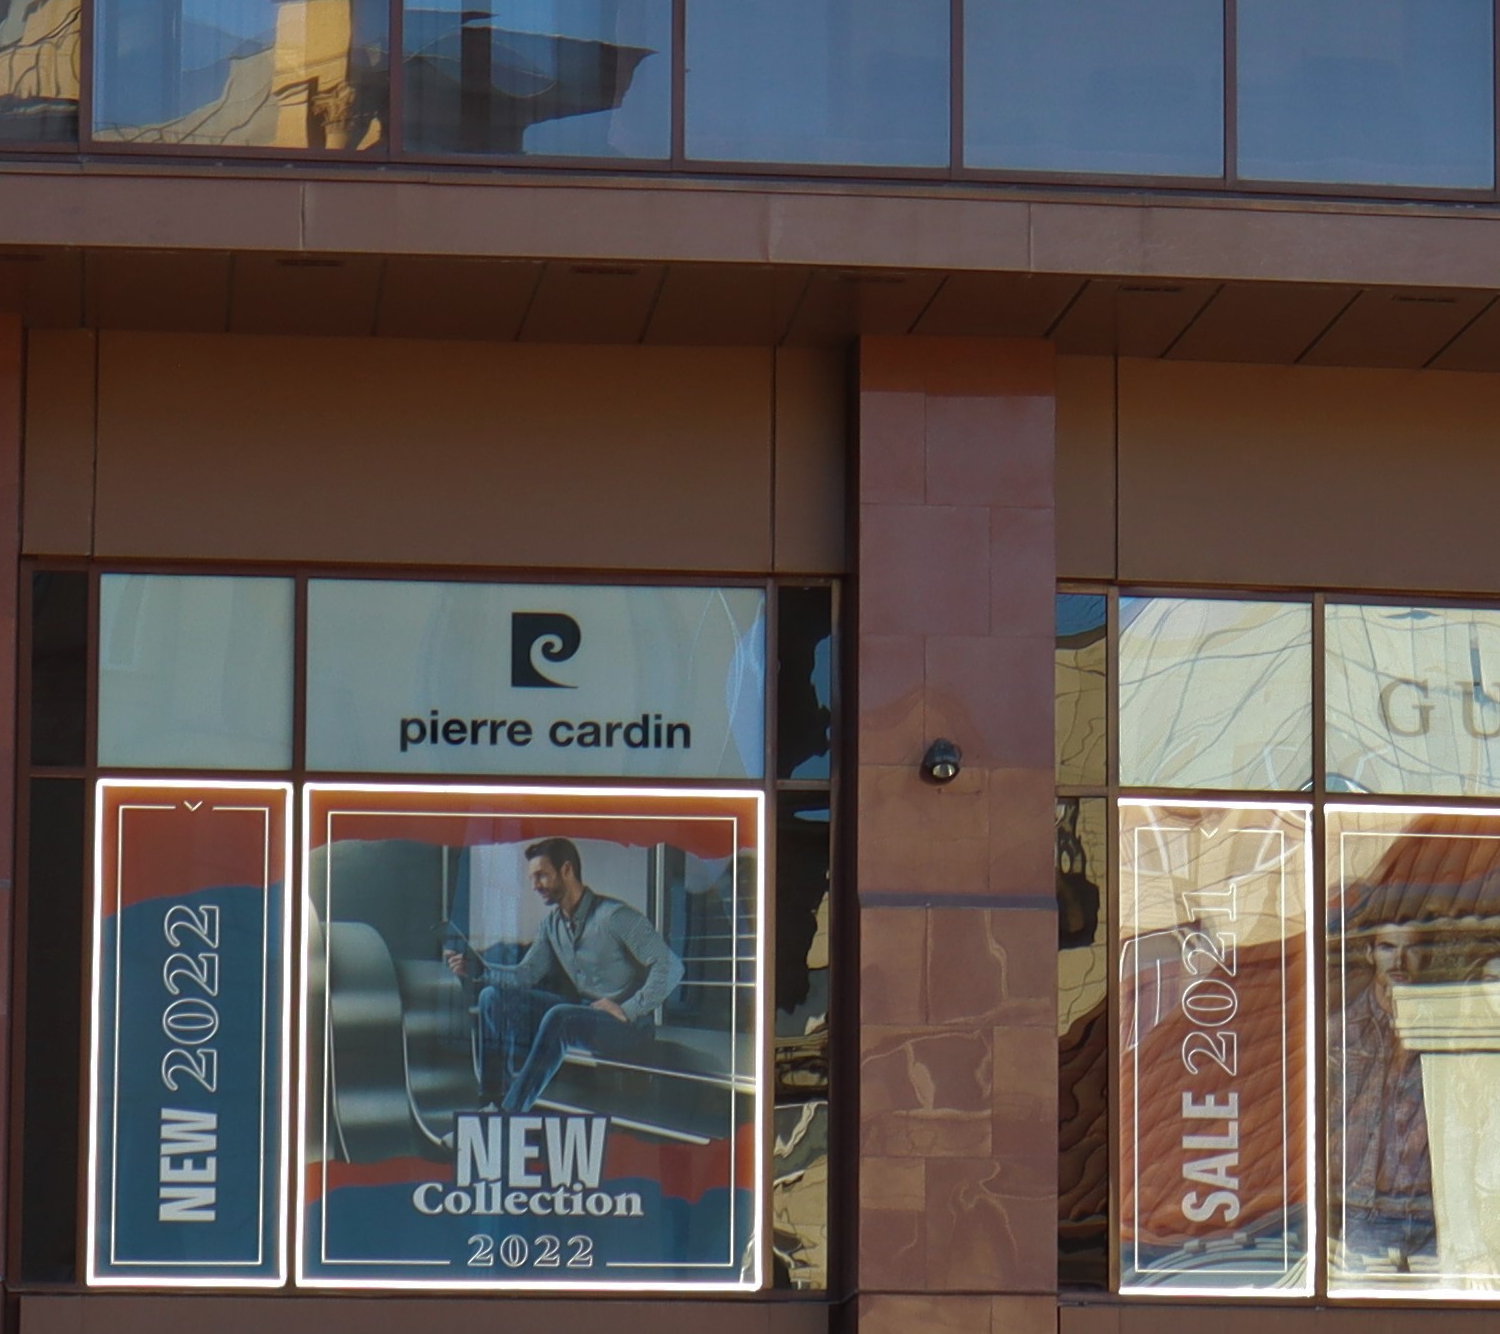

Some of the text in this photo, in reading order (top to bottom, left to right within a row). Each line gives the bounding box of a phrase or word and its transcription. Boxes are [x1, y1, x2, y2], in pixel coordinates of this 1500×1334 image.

[400, 710, 691, 753] pierre cardin
[158, 905, 220, 1221] NEW 2022
[1181, 882, 1241, 1223] SALE 2021
[456, 1114, 607, 1189] NEW
[412, 1180, 645, 1216] Collection
[467, 1233, 594, 1268] 2022
